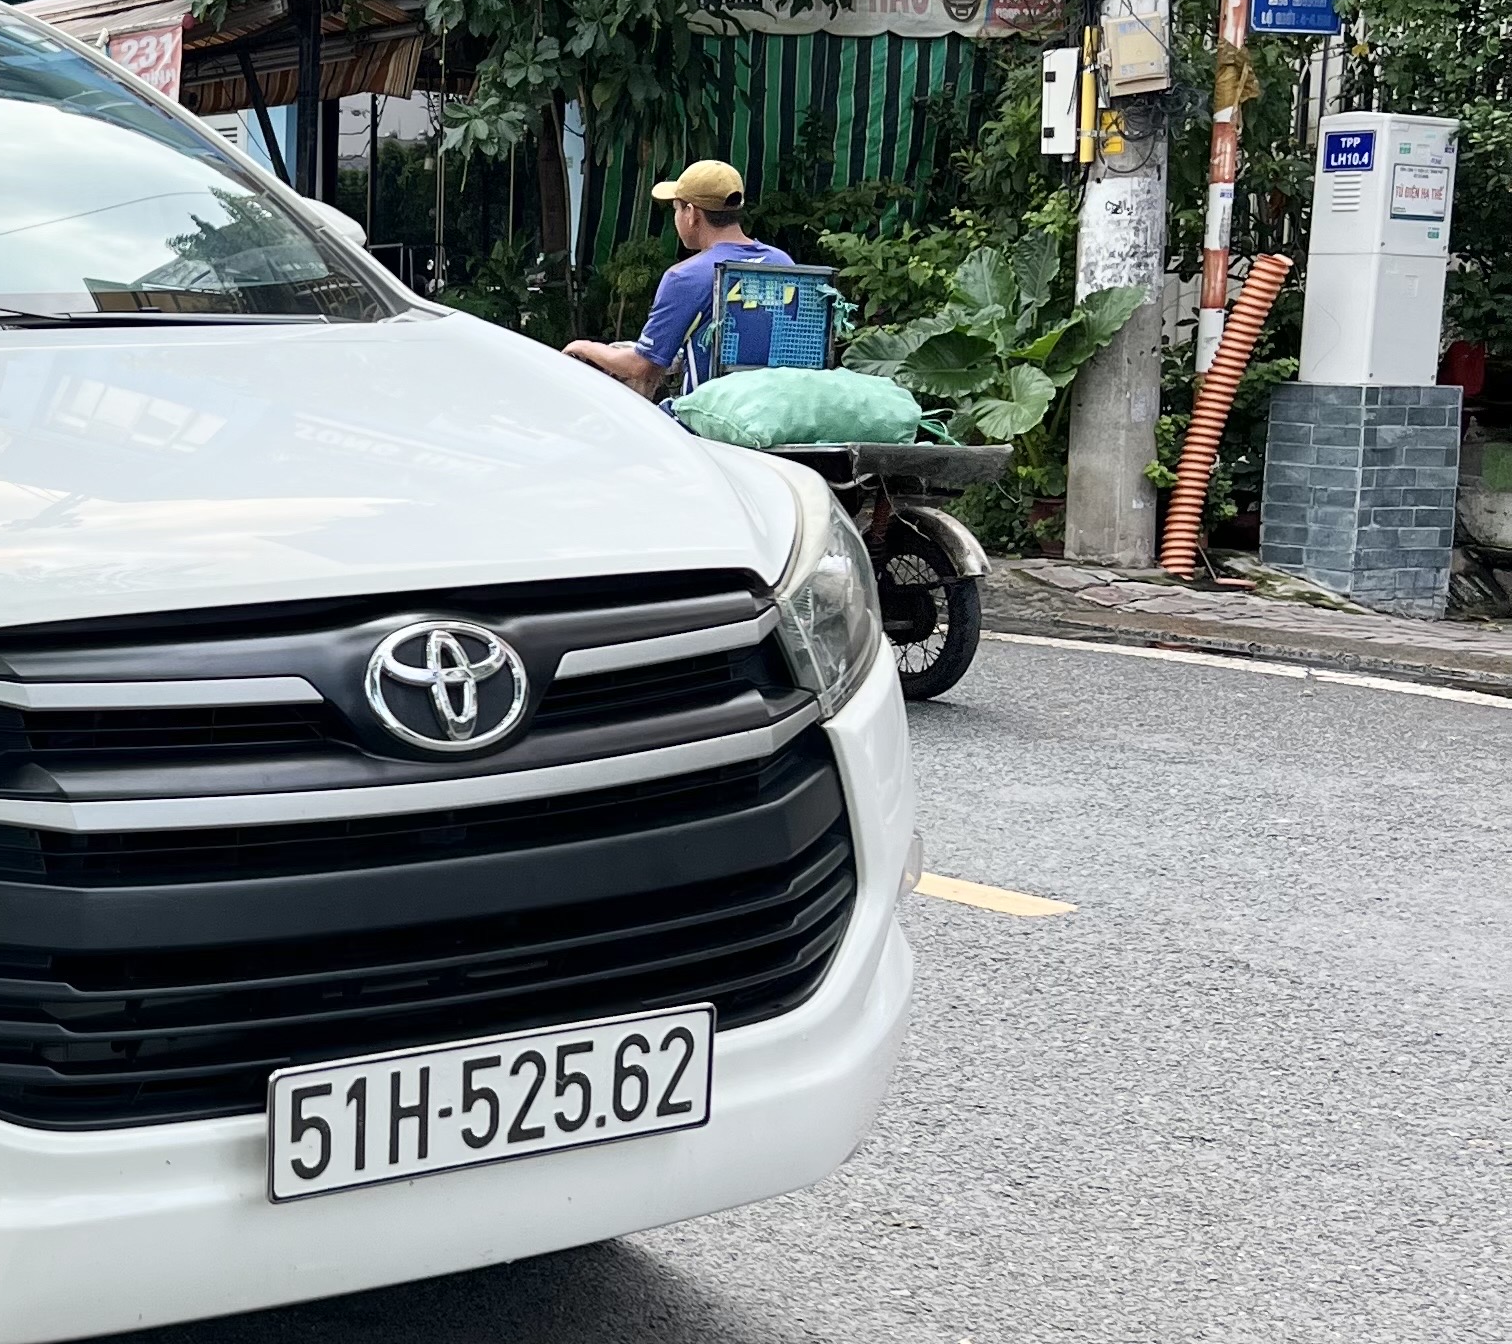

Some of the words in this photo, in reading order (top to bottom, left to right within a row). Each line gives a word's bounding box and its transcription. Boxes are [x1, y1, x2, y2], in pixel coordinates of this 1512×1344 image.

[120, 32, 173, 73] 231
[1340, 137, 1361, 149] TPP
[1330, 152, 1369, 166] LH10.4
[290, 1025, 695, 1180] 51H-525.62
